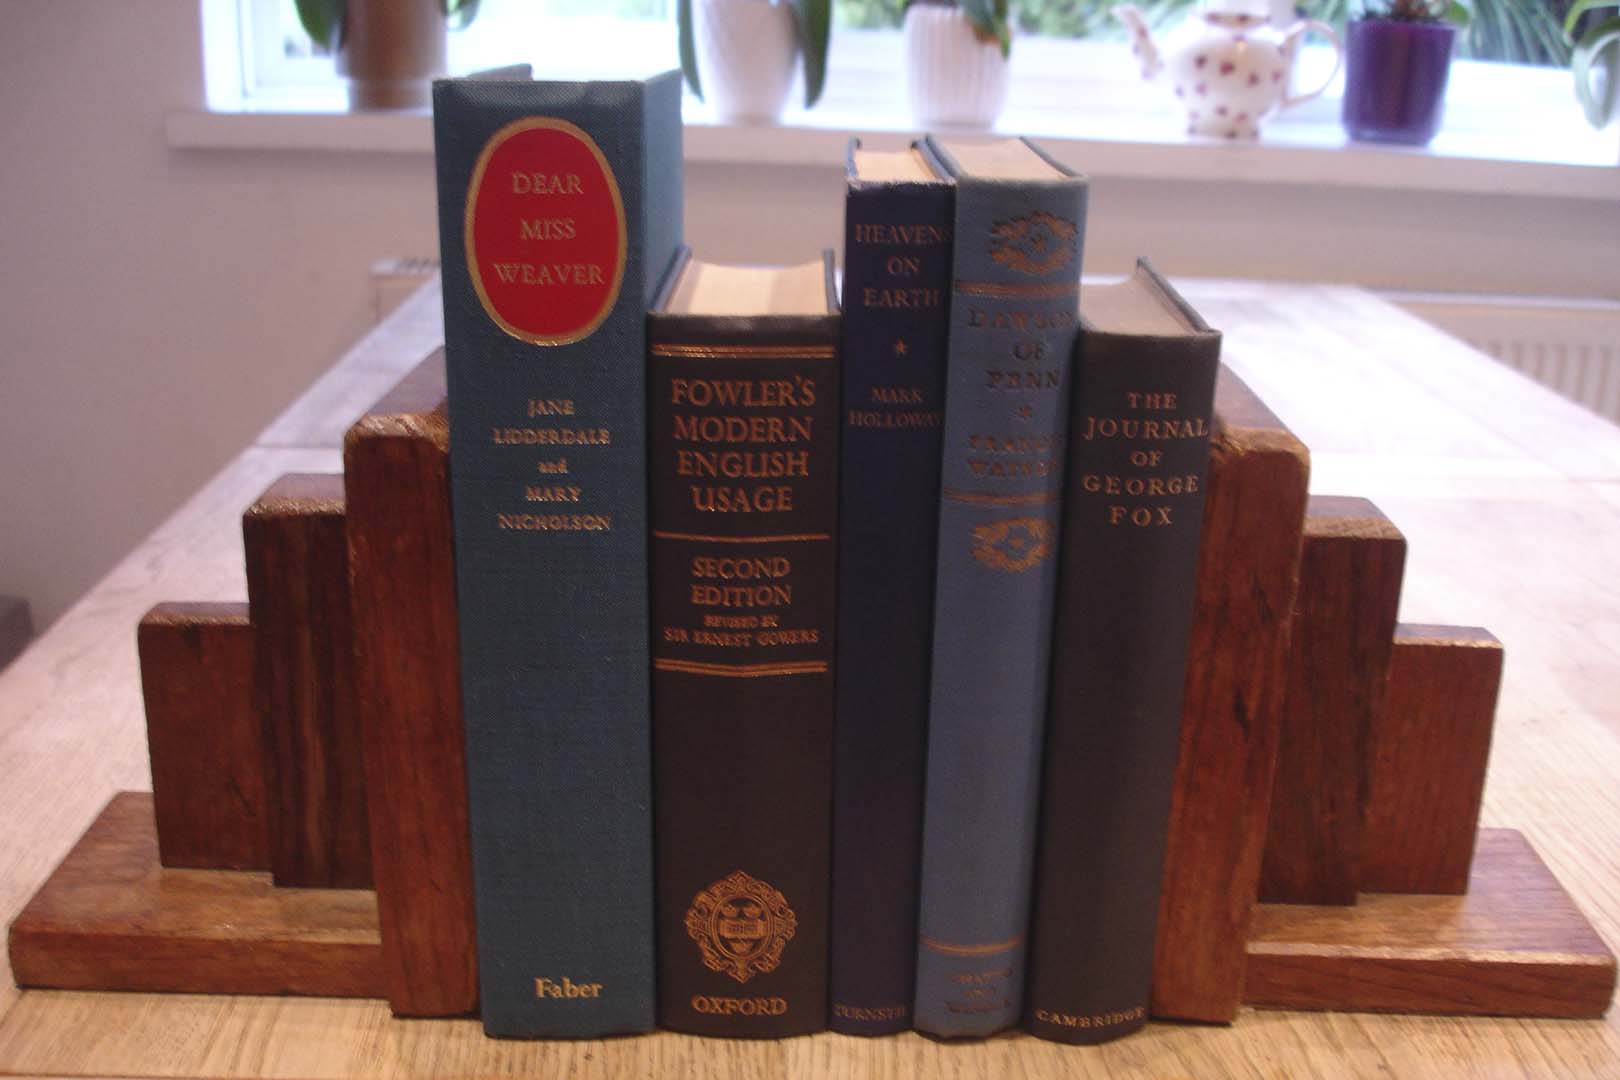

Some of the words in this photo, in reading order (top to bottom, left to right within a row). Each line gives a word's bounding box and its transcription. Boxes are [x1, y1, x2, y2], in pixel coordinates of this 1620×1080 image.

[511, 172, 584, 195] DEAR
[520, 218, 576, 241] MISS
[493, 262, 605, 286] WEAVER
[887, 256, 920, 276] ON
[863, 288, 940, 309] EARTH
[986, 370, 1062, 389] PENN
[671, 375, 816, 407] FOWLER'S
[870, 388, 924, 404] MARK
[1126, 392, 1177, 409] THE
[528, 399, 576, 418] JANE
[672, 416, 814, 443] MODERN
[1083, 417, 1208, 440] JOURNAL
[537, 459, 568, 475] and
[676, 450, 809, 478] ENGLISH
[1130, 451, 1163, 467] OF
[526, 486, 581, 503] MARY
[1082, 475, 1199, 496] GEORGE
[690, 485, 793, 513] USAGE
[498, 513, 611, 531] NICHOLSON
[1109, 506, 1173, 527] FOX
[690, 556, 791, 579] SECOND
[690, 584, 792, 607] EDITION
[664, 627, 689, 643] SIR
[693, 630, 751, 647] ERNEST
[757, 629, 819, 646] GOWERS
[534, 976, 603, 998] Faber
[691, 996, 788, 1015] OXFORD
[1034, 1005, 1146, 1029] CAMBRIDGE
